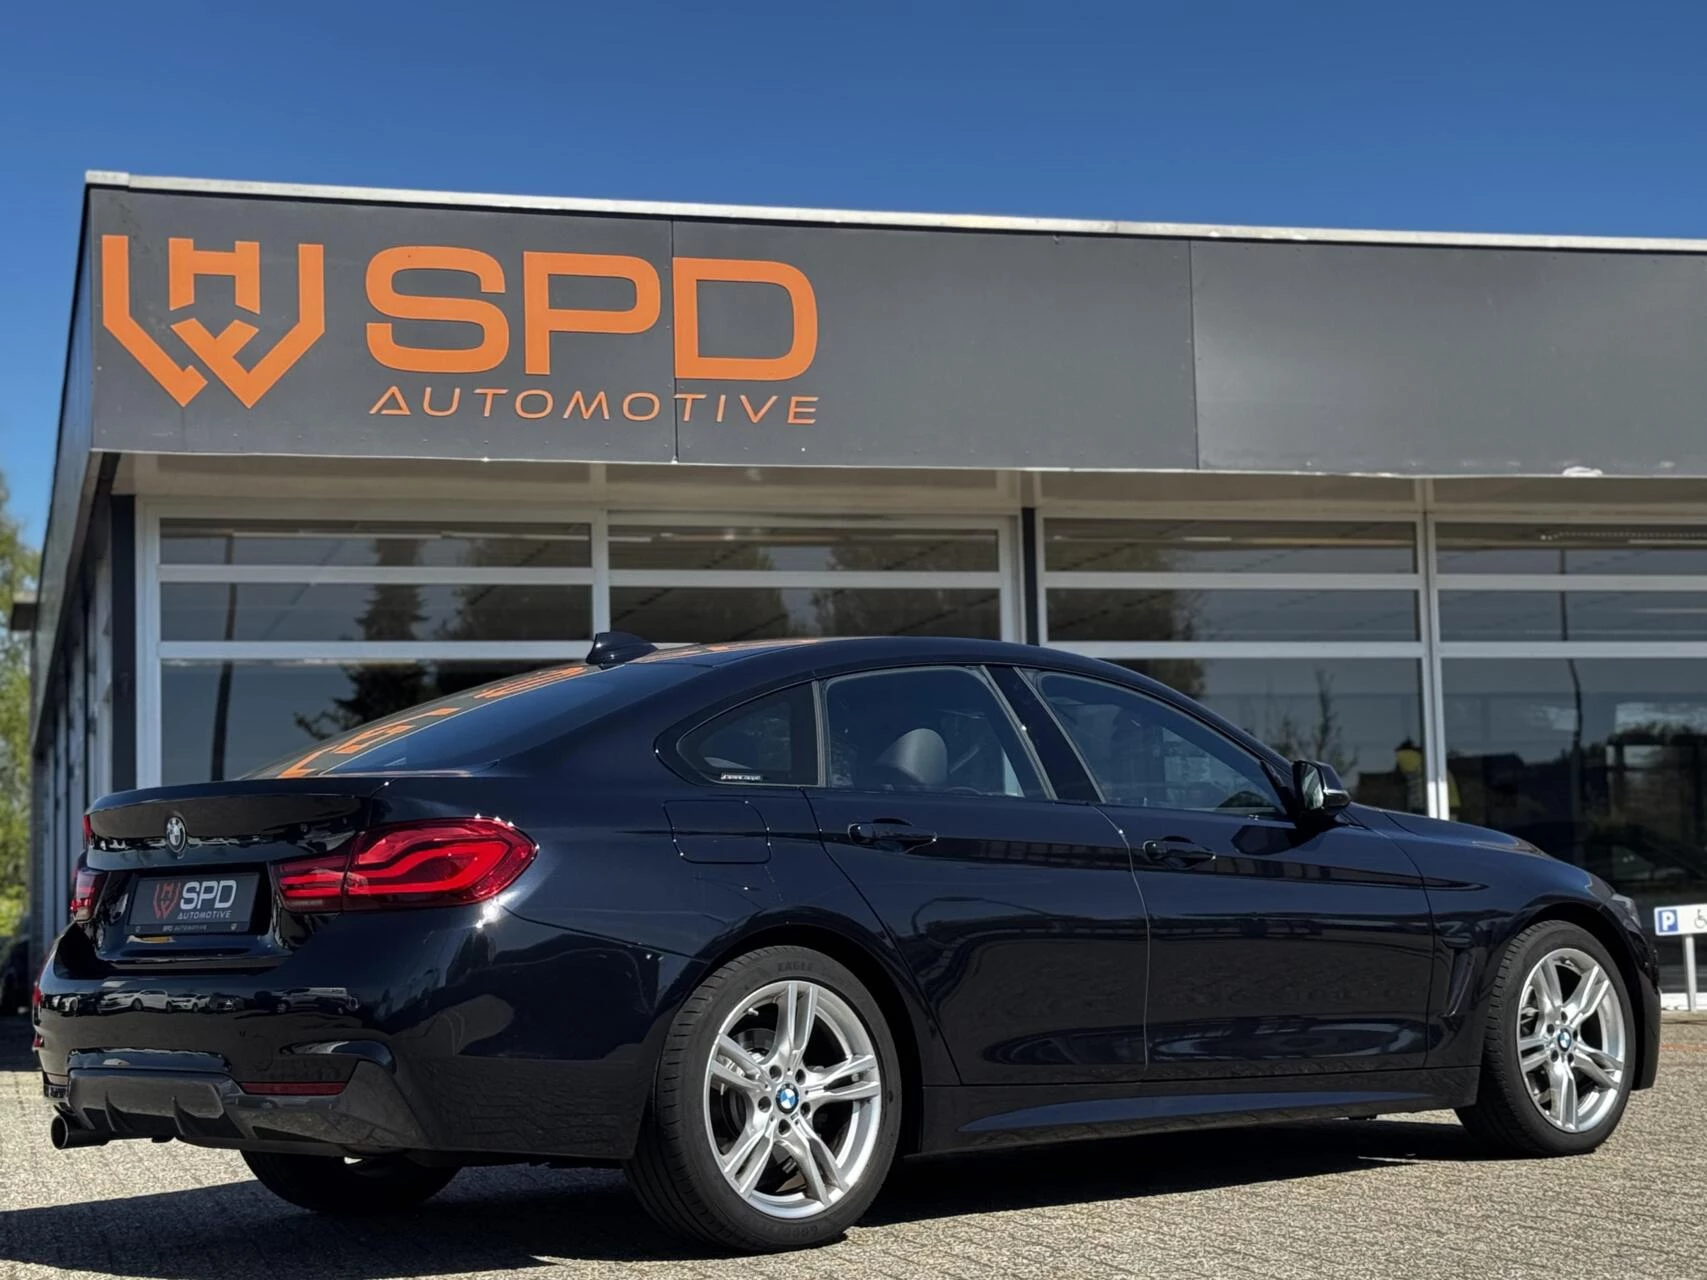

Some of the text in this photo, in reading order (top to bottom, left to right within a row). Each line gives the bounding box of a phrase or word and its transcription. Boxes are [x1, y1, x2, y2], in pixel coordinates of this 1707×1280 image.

[365, 244, 819, 382] SPD
[369, 385, 819, 425] AUTOMOTIVE
[180, 880, 237, 910] SPD
[178, 910, 232, 920] AUTOMOTIVE
[1661, 911, 1675, 931] P
